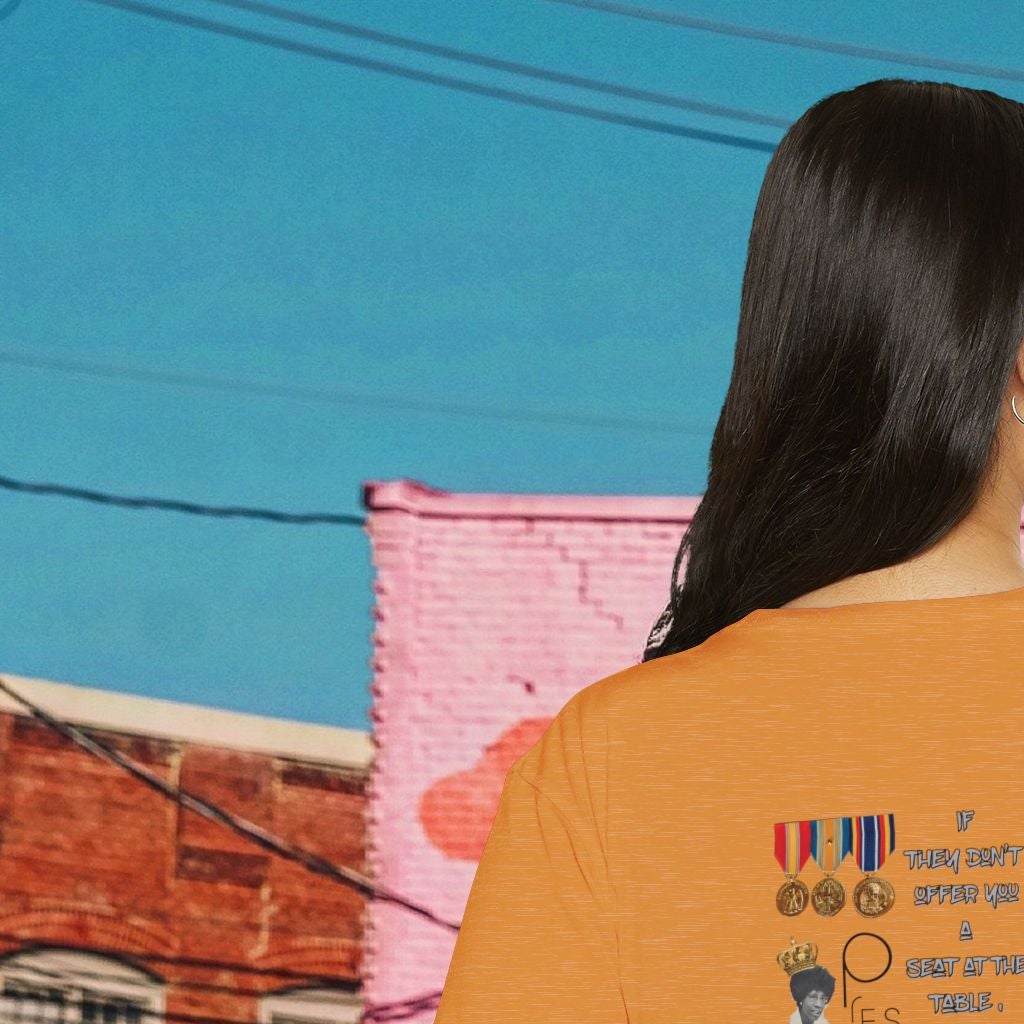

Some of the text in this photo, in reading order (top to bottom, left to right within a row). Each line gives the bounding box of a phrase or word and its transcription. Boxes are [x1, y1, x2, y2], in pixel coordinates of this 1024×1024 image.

[956, 810, 975, 832] IF
[903, 849, 960, 874] THEY
[914, 882, 1019, 909] OFFER YOU
[959, 920, 973, 941] A
[906, 957, 960, 978] SEAT
[963, 956, 989, 977] AT
